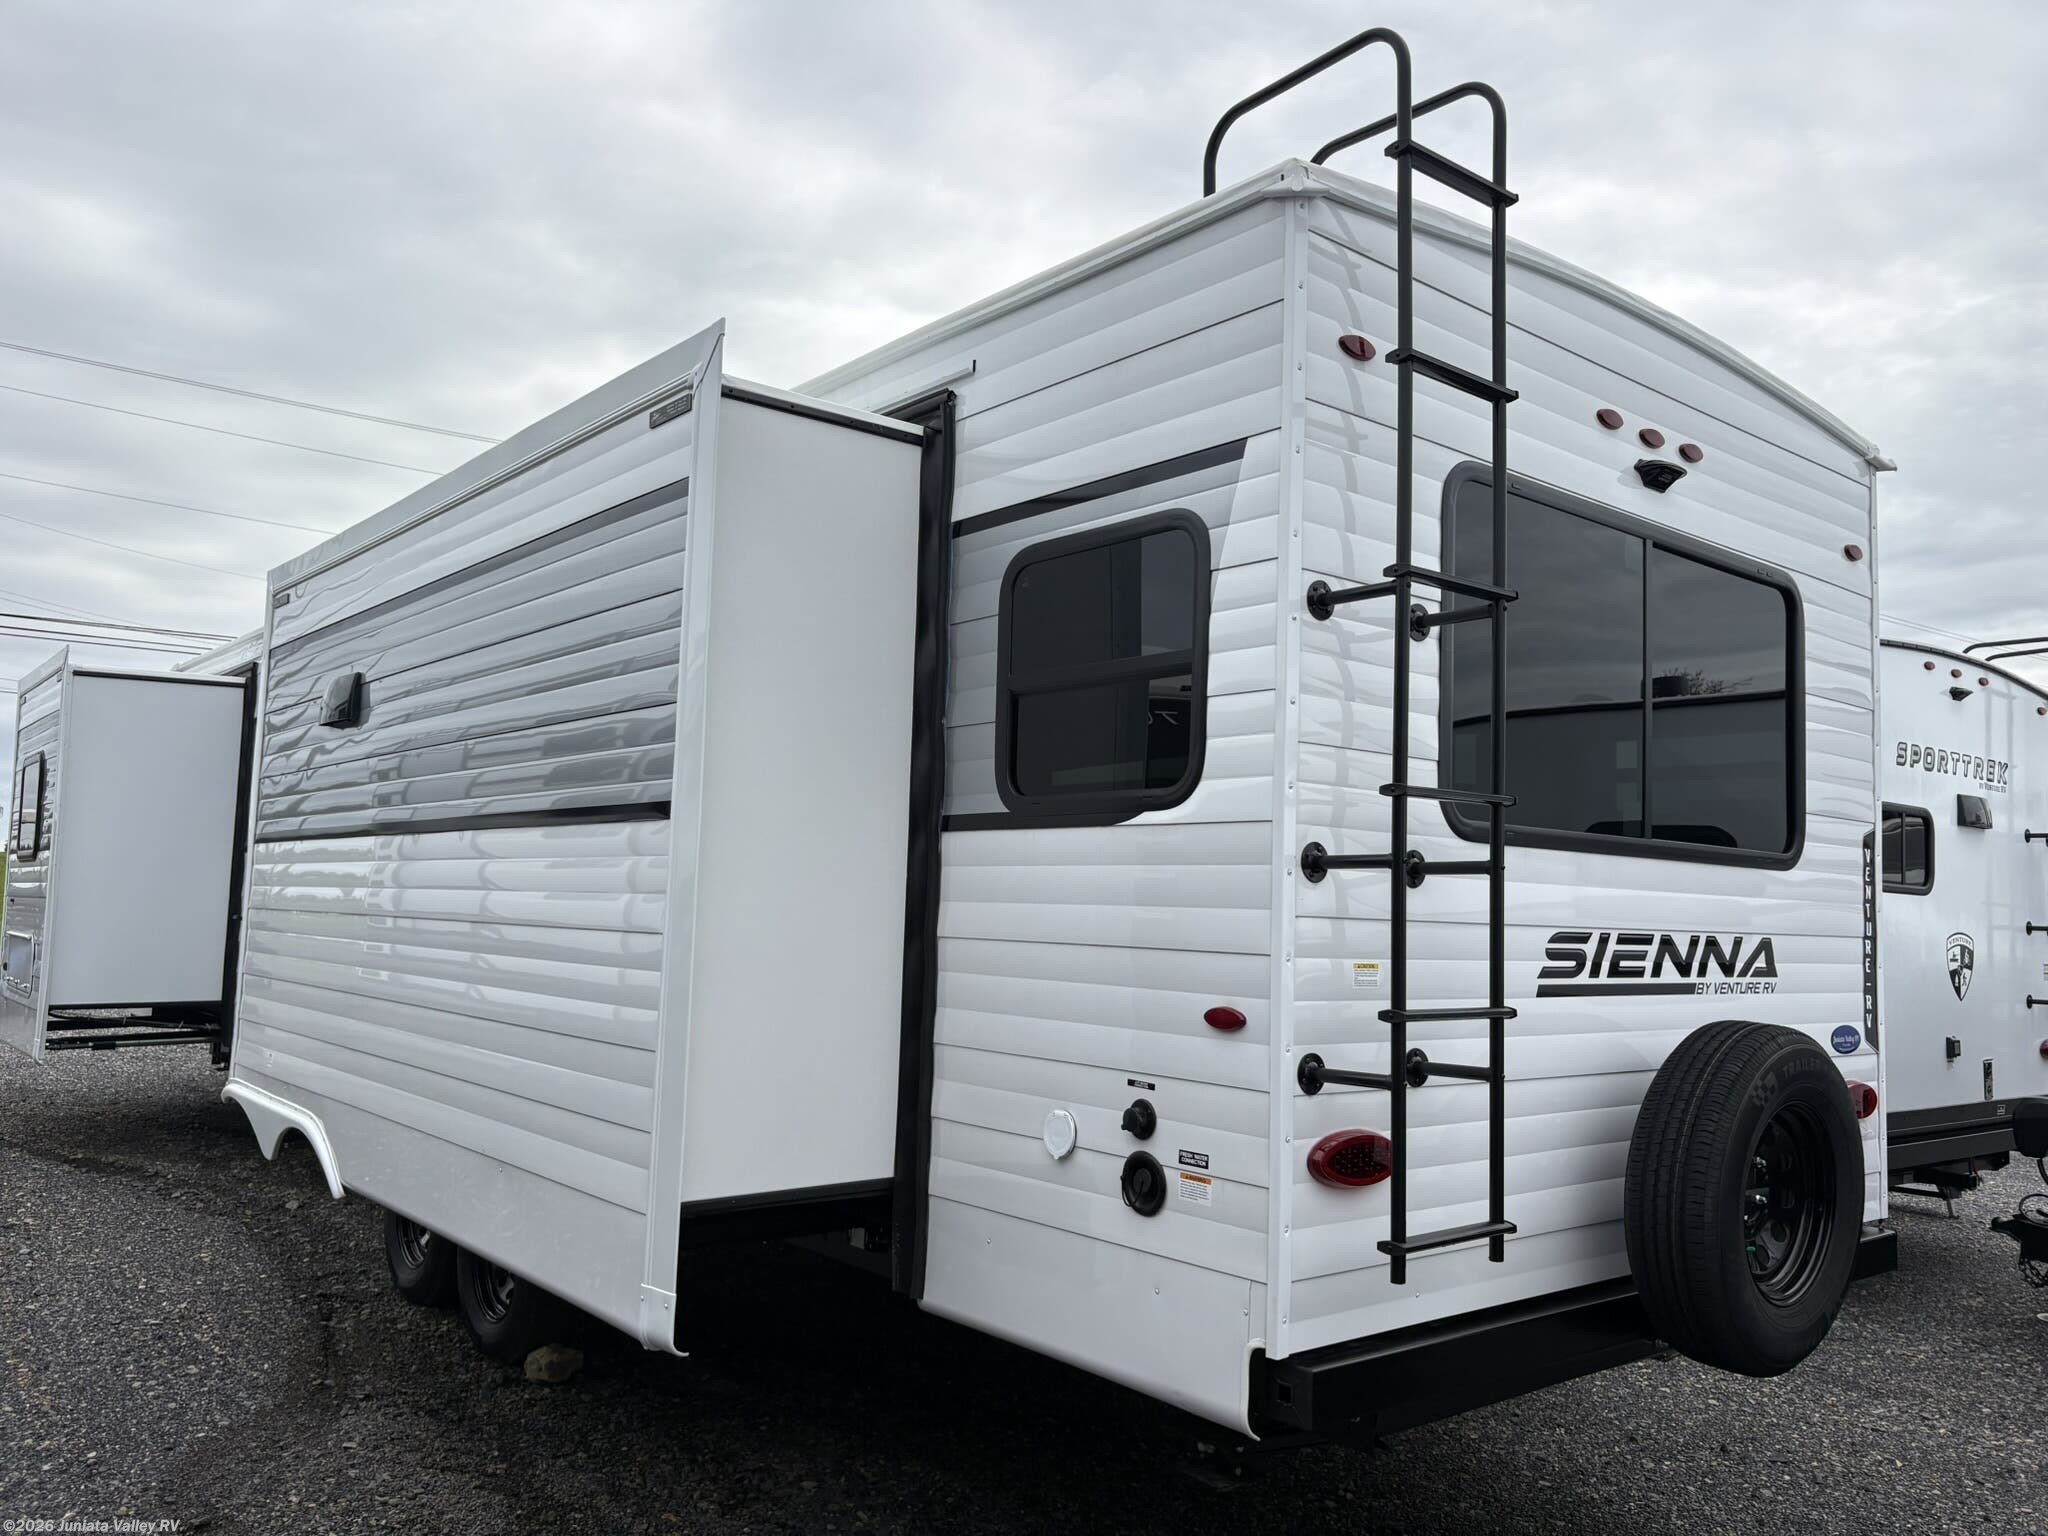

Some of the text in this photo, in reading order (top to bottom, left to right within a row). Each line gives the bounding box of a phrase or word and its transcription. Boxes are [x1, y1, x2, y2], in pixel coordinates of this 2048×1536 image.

[1895, 741, 2009, 786] SPORTTREK
[1537, 931, 1778, 979] SIENNA
[1696, 982, 1777, 995] BY VENTURE RV
